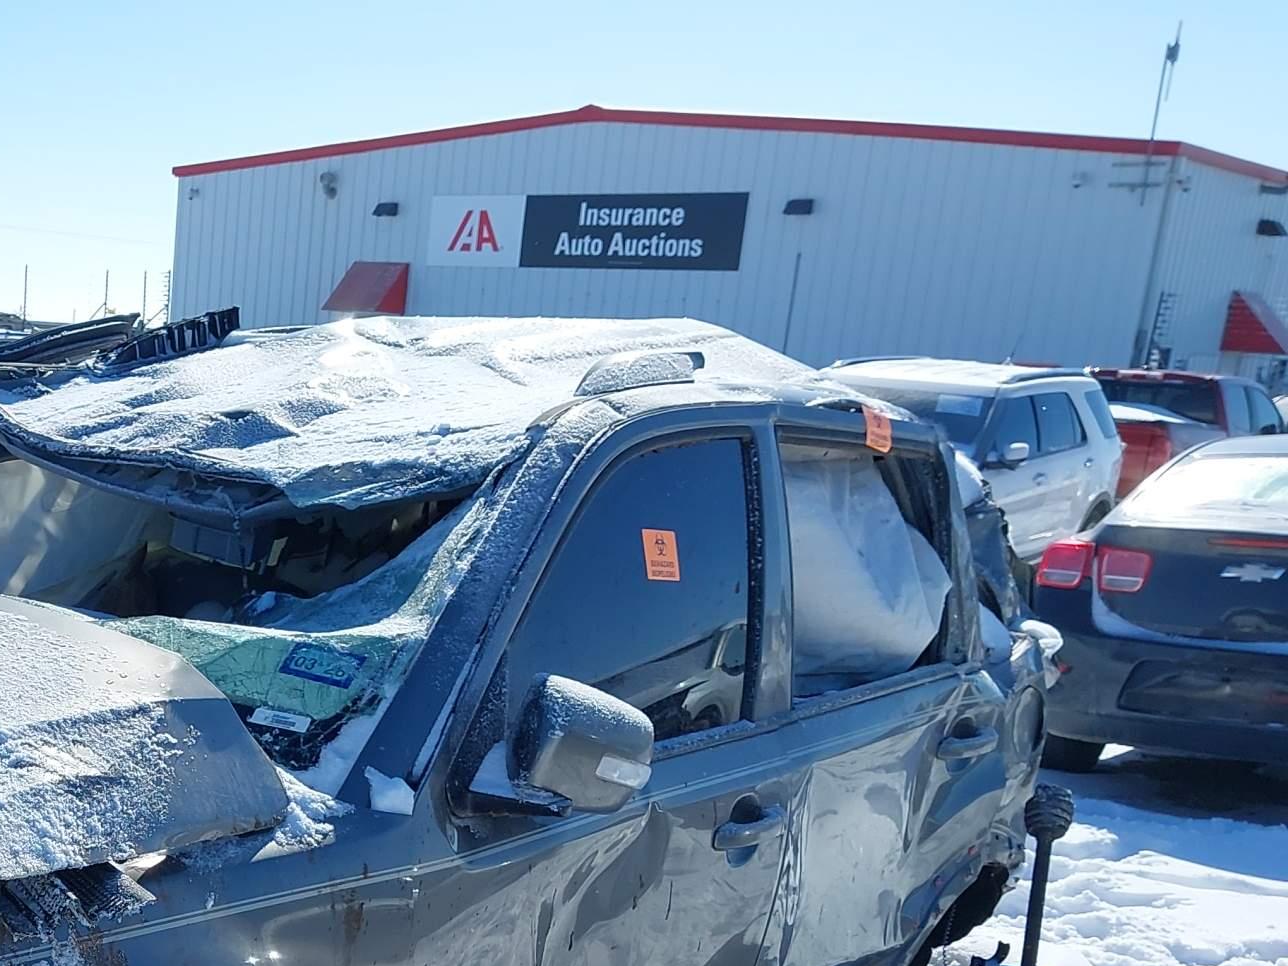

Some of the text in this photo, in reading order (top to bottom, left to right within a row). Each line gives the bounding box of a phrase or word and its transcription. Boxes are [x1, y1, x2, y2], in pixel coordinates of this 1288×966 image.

[579, 202, 685, 226] Insurance
[554, 232, 703, 257] Auto Auctions
